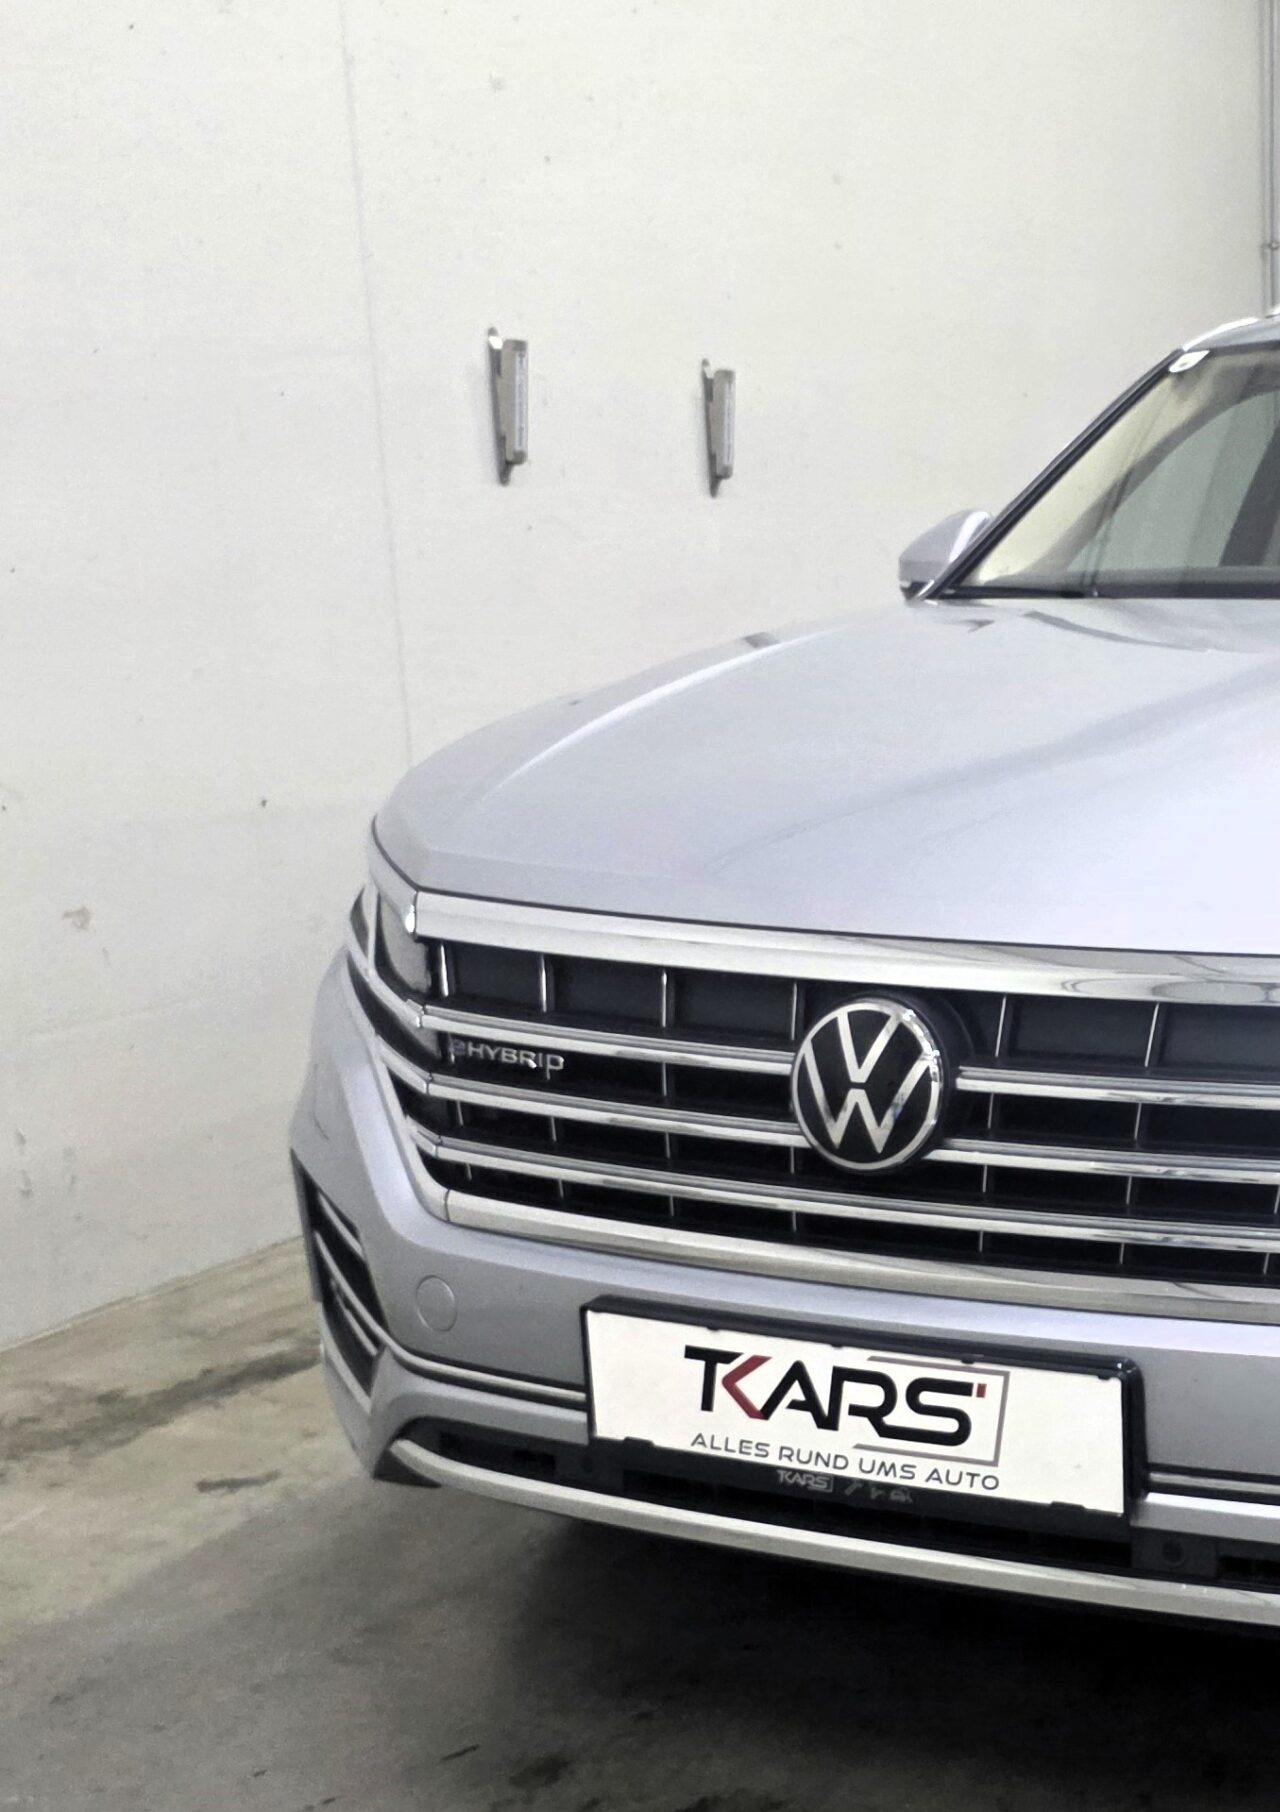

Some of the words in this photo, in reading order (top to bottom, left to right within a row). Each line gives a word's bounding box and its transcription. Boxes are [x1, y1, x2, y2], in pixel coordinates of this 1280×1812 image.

[690, 1432, 770, 1458] ALLES
[778, 1445, 849, 1471] RUND
[858, 1459, 918, 1480] UMS
[925, 1468, 1001, 1491] AUTO
